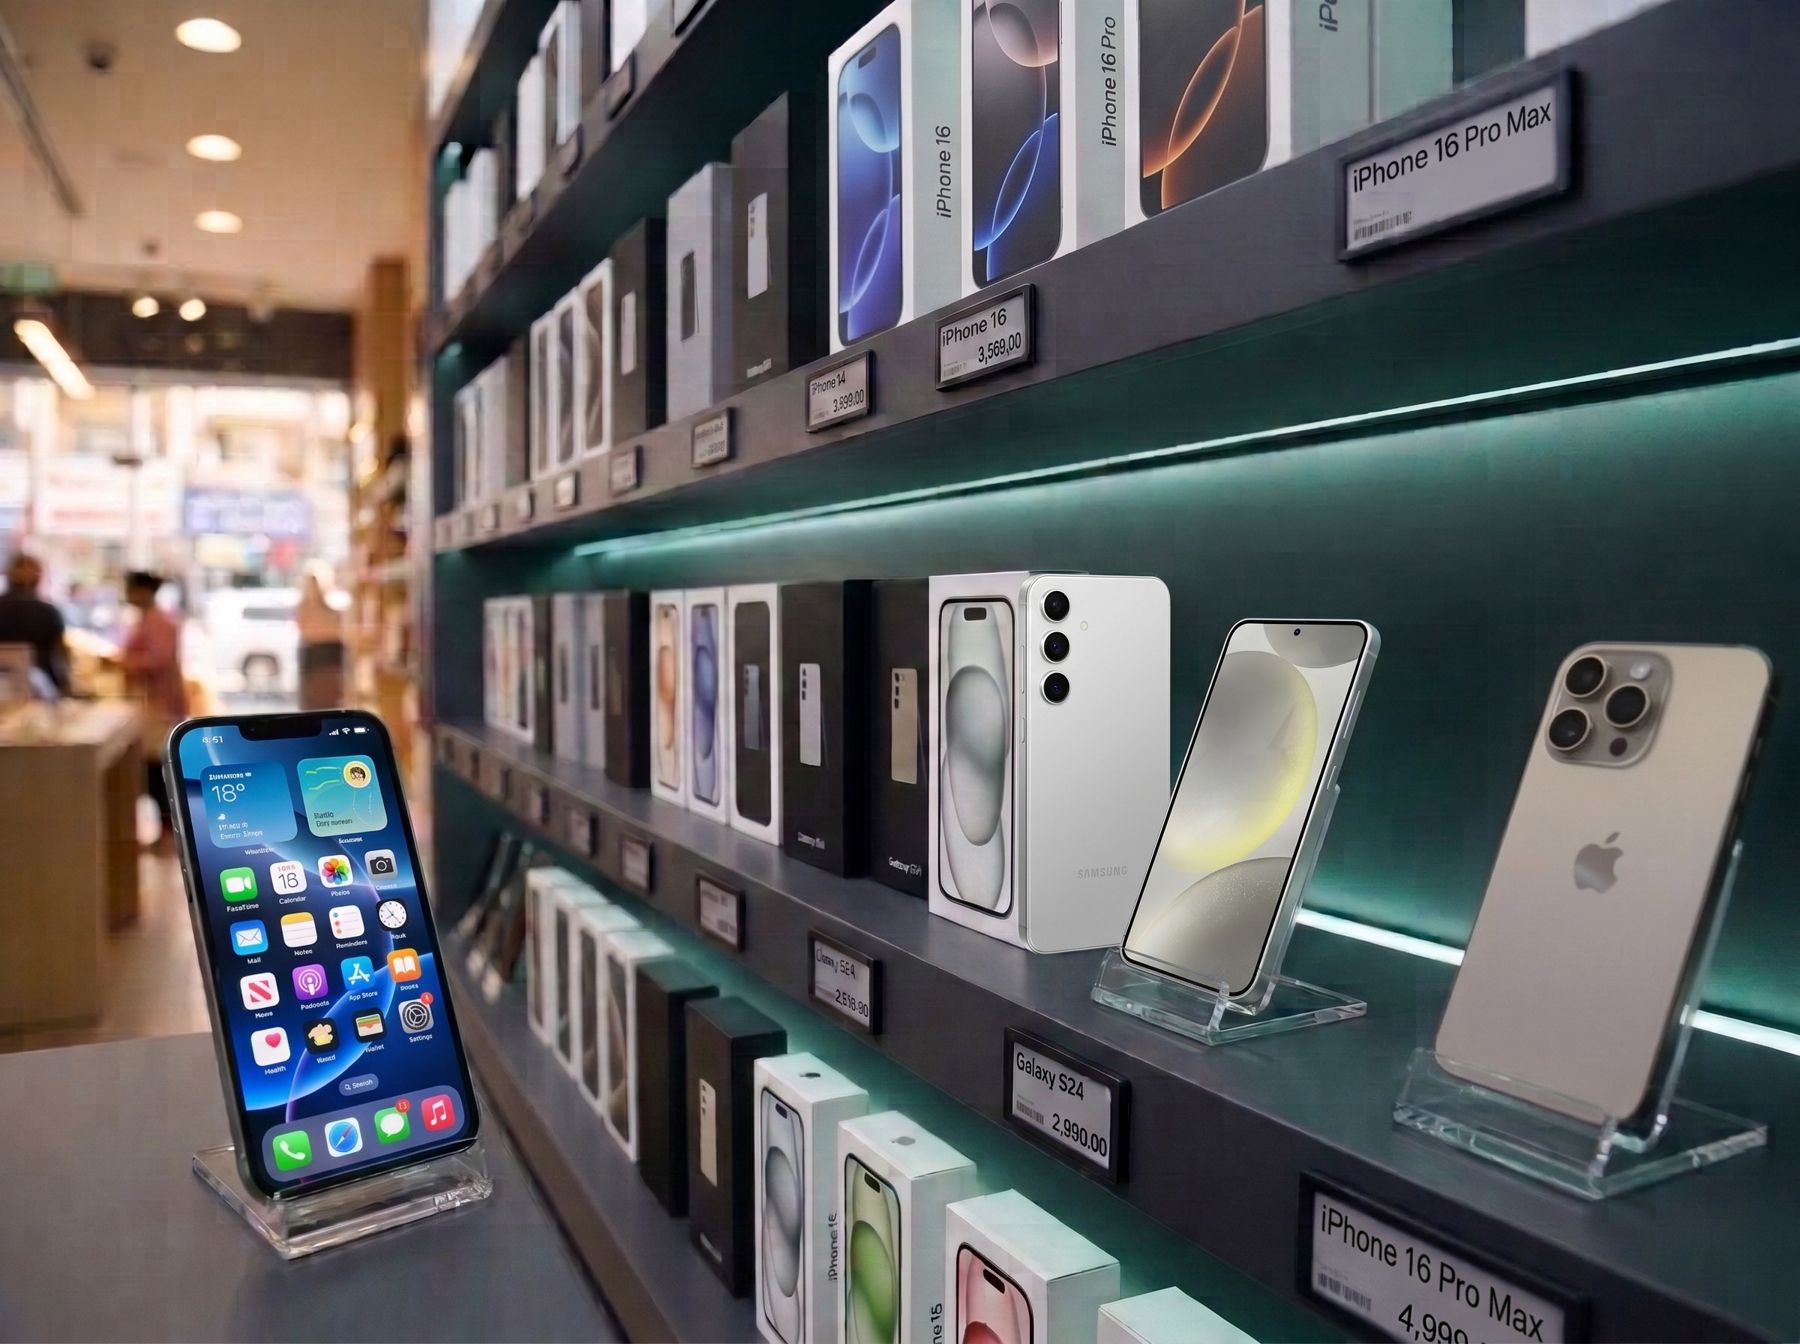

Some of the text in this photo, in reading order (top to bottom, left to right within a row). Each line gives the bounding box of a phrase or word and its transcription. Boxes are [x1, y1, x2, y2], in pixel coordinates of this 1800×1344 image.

[1319, 0, 1338, 32] iP
[1101, 16, 1117, 146] iPhone 16 Pro
[1353, 102, 1551, 193] iPhone 16 Pro Max
[935, 125, 952, 218] iPhone 16
[942, 308, 1007, 348] iPhone 16
[978, 332, 1022, 365] 3,569,00
[278, 872, 299, 889] 18
[1077, 865, 1128, 879] SAMSUNG
[247, 957, 262, 965] Mail
[336, 939, 368, 950] Reminders
[1016, 1051, 1084, 1100] Galaxy S24
[1052, 1113, 1107, 1157] 2,990.00
[1321, 1204, 1544, 1342] iPhone 16 Pro Max
